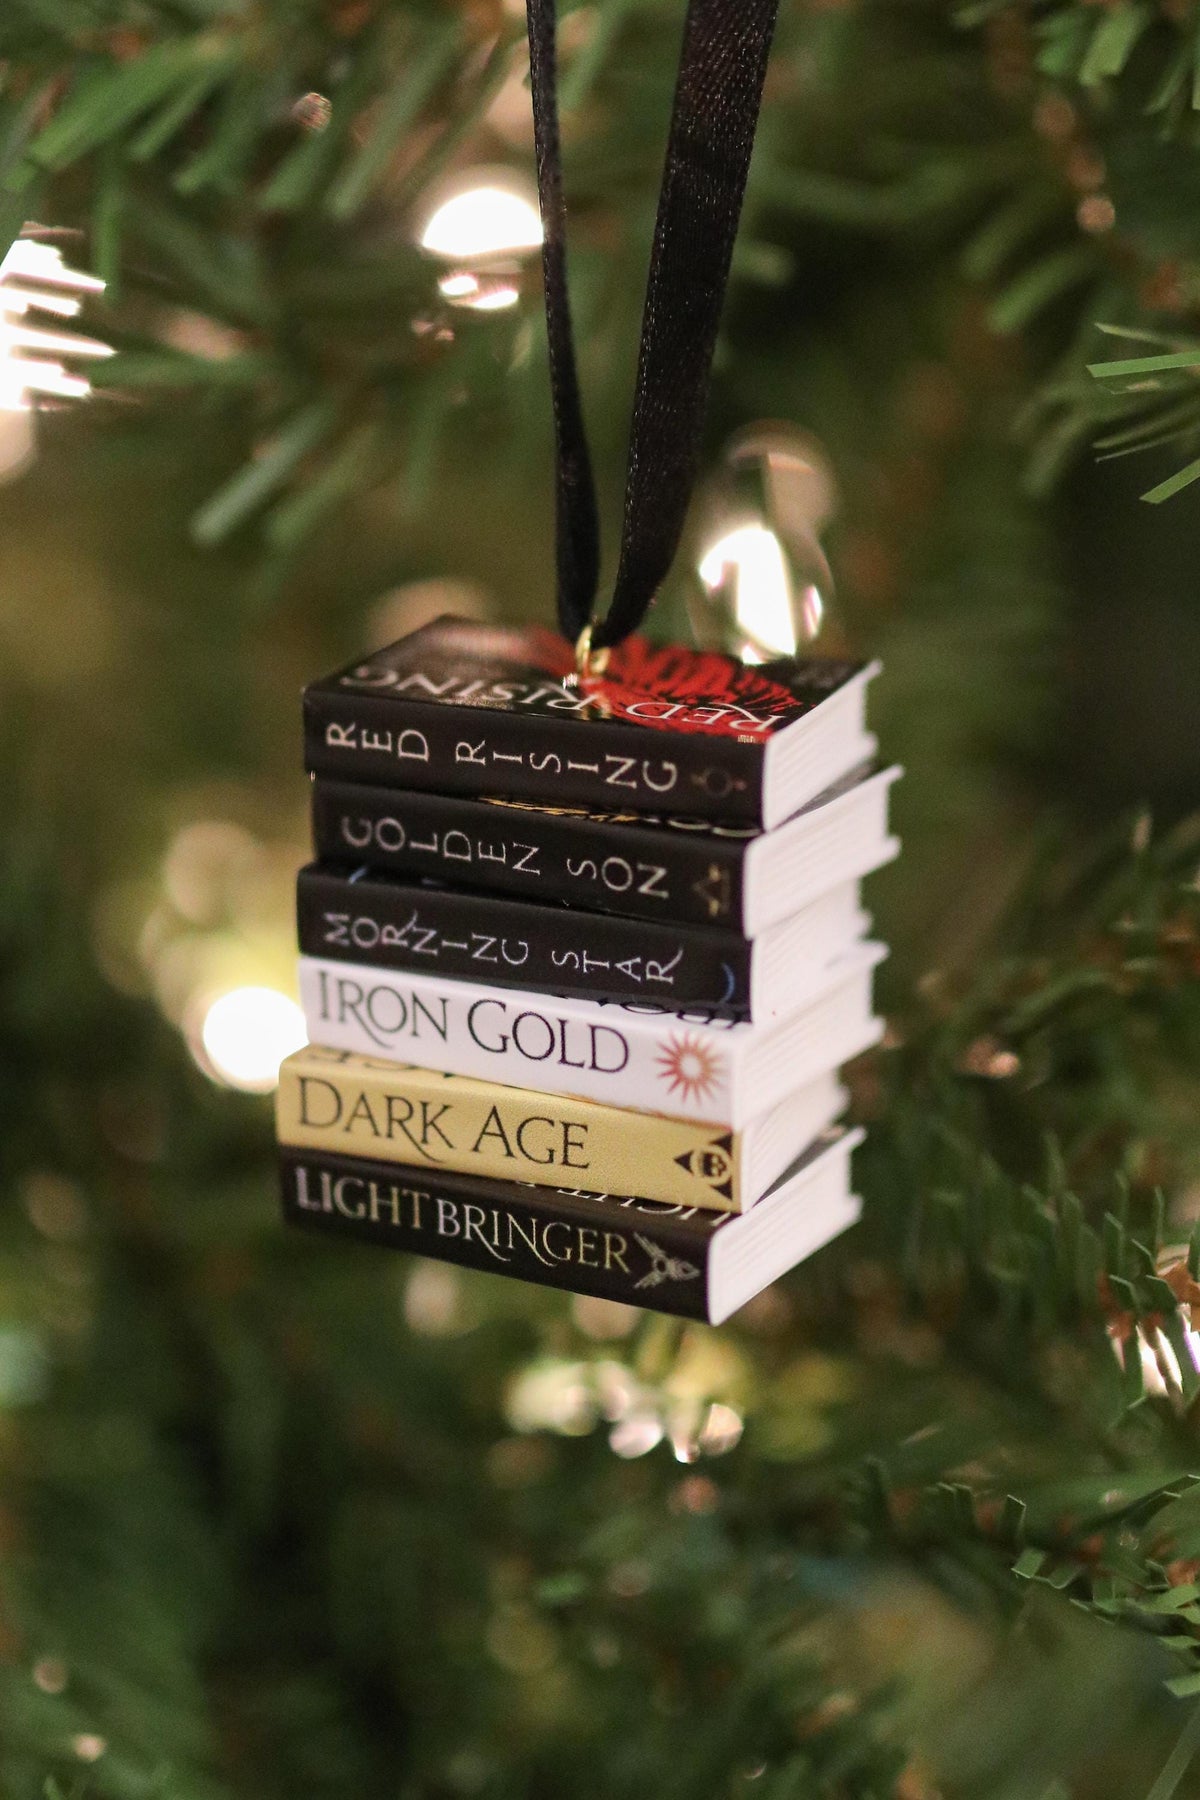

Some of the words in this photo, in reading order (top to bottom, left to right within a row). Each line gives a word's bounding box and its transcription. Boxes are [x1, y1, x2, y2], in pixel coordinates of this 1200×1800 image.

[340, 665, 600, 711] RISING
[625, 702, 786, 733] RED
[326, 721, 430, 763] RED
[455, 740, 678, 792] RISING
[341, 815, 541, 876] GOLDEN
[566, 856, 669, 899] SON
[323, 910, 529, 966] MORNING
[551, 948, 684, 985] STAR
[317, 970, 449, 1049] IRON
[467, 998, 630, 1074] GOLD
[297, 1075, 455, 1164] DARK
[471, 1104, 590, 1169] AGE
[296, 1166, 631, 1274] LIGHTBRINGER
